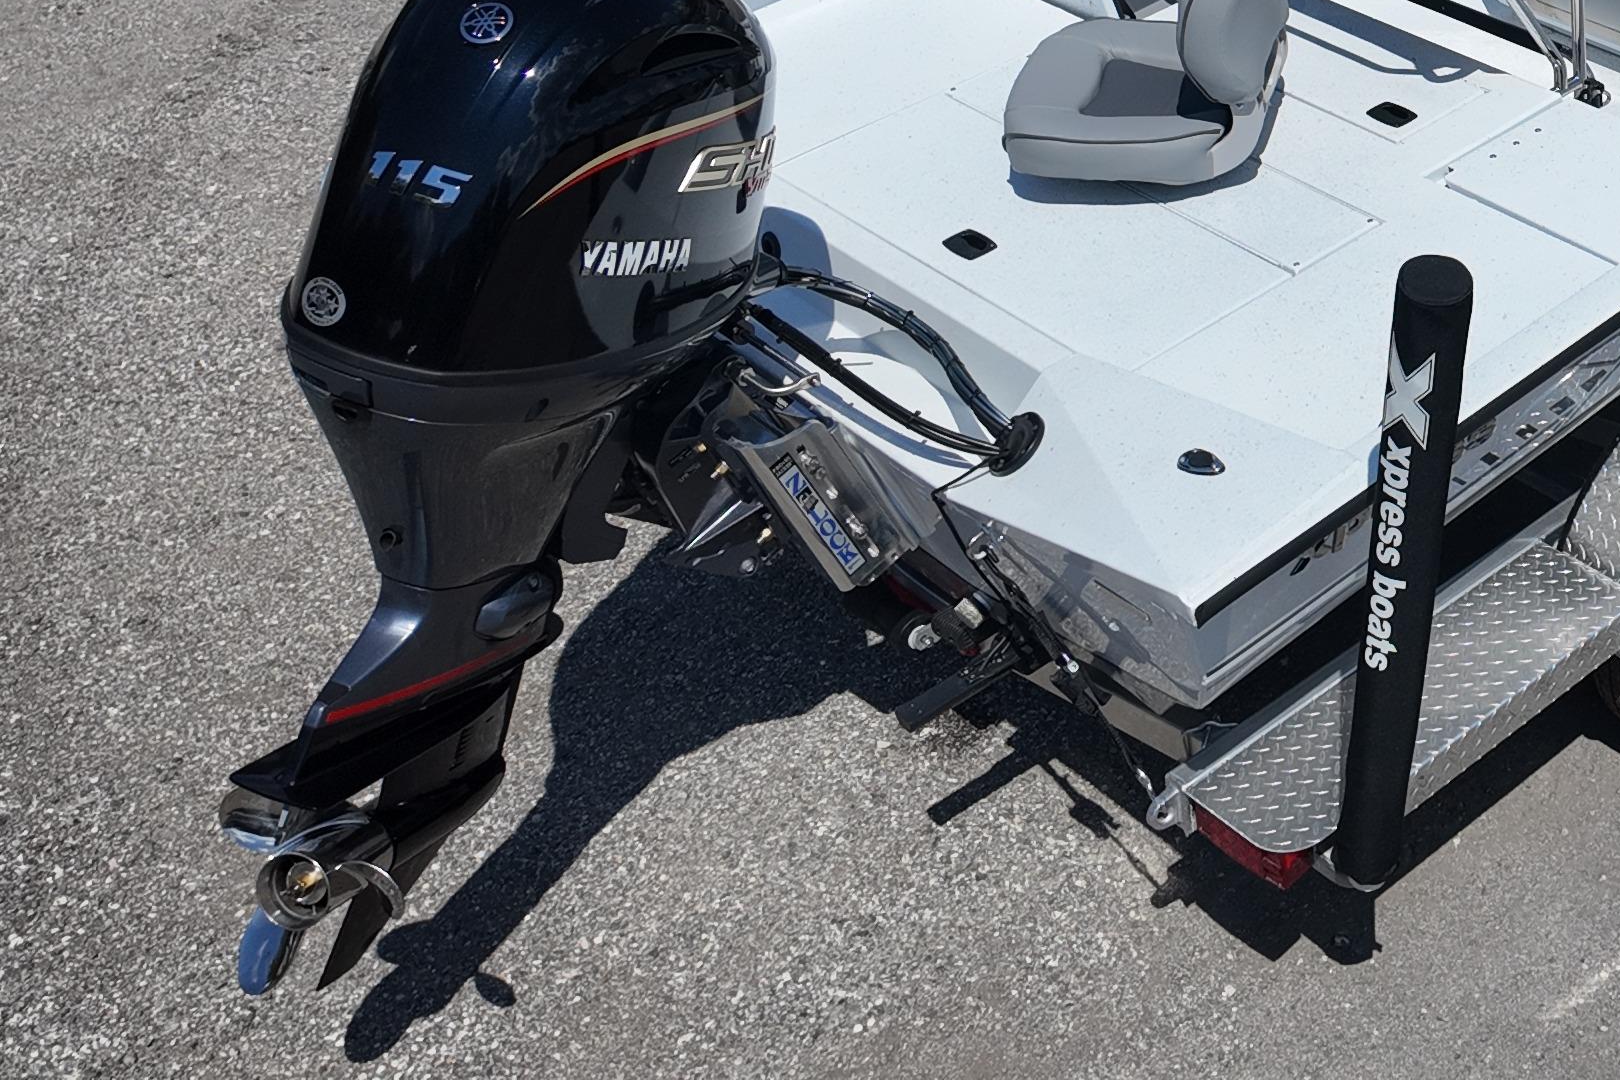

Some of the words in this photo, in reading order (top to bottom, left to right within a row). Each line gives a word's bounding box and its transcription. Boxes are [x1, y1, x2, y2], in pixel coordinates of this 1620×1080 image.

[371, 150, 474, 209] 115
[579, 237, 692, 277] YAMAHA
[1376, 435, 1412, 568] xpress
[1364, 570, 1407, 671] boats
